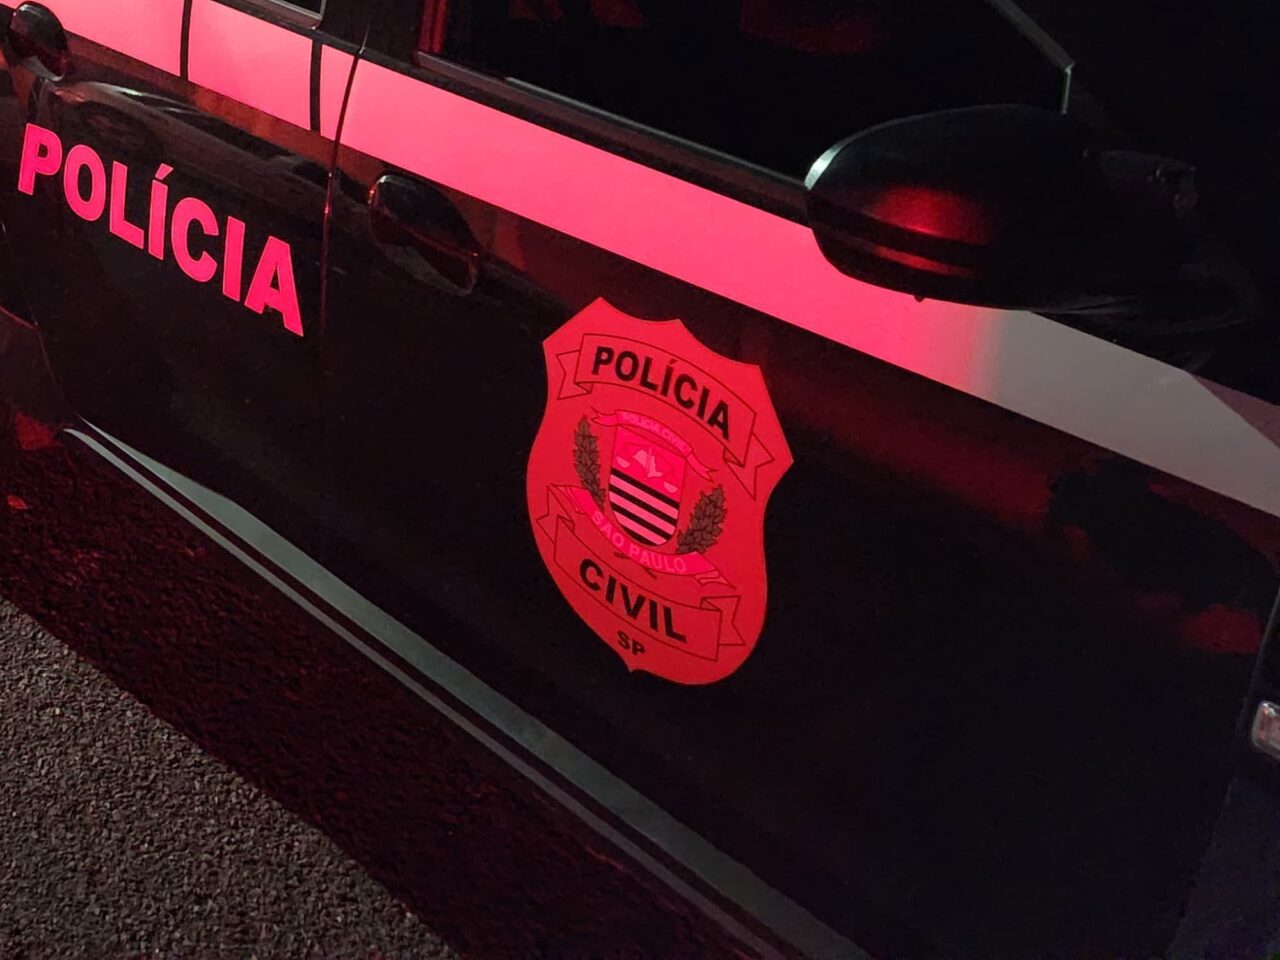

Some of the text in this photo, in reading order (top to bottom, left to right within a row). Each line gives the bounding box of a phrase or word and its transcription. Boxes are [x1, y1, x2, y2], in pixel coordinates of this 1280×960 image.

[18, 123, 304, 337] POLÍCIA
[592, 346, 731, 441] POLÍCIA
[629, 544, 687, 573] PAULO
[579, 559, 687, 644] CIVIL
[617, 630, 645, 656] SP
